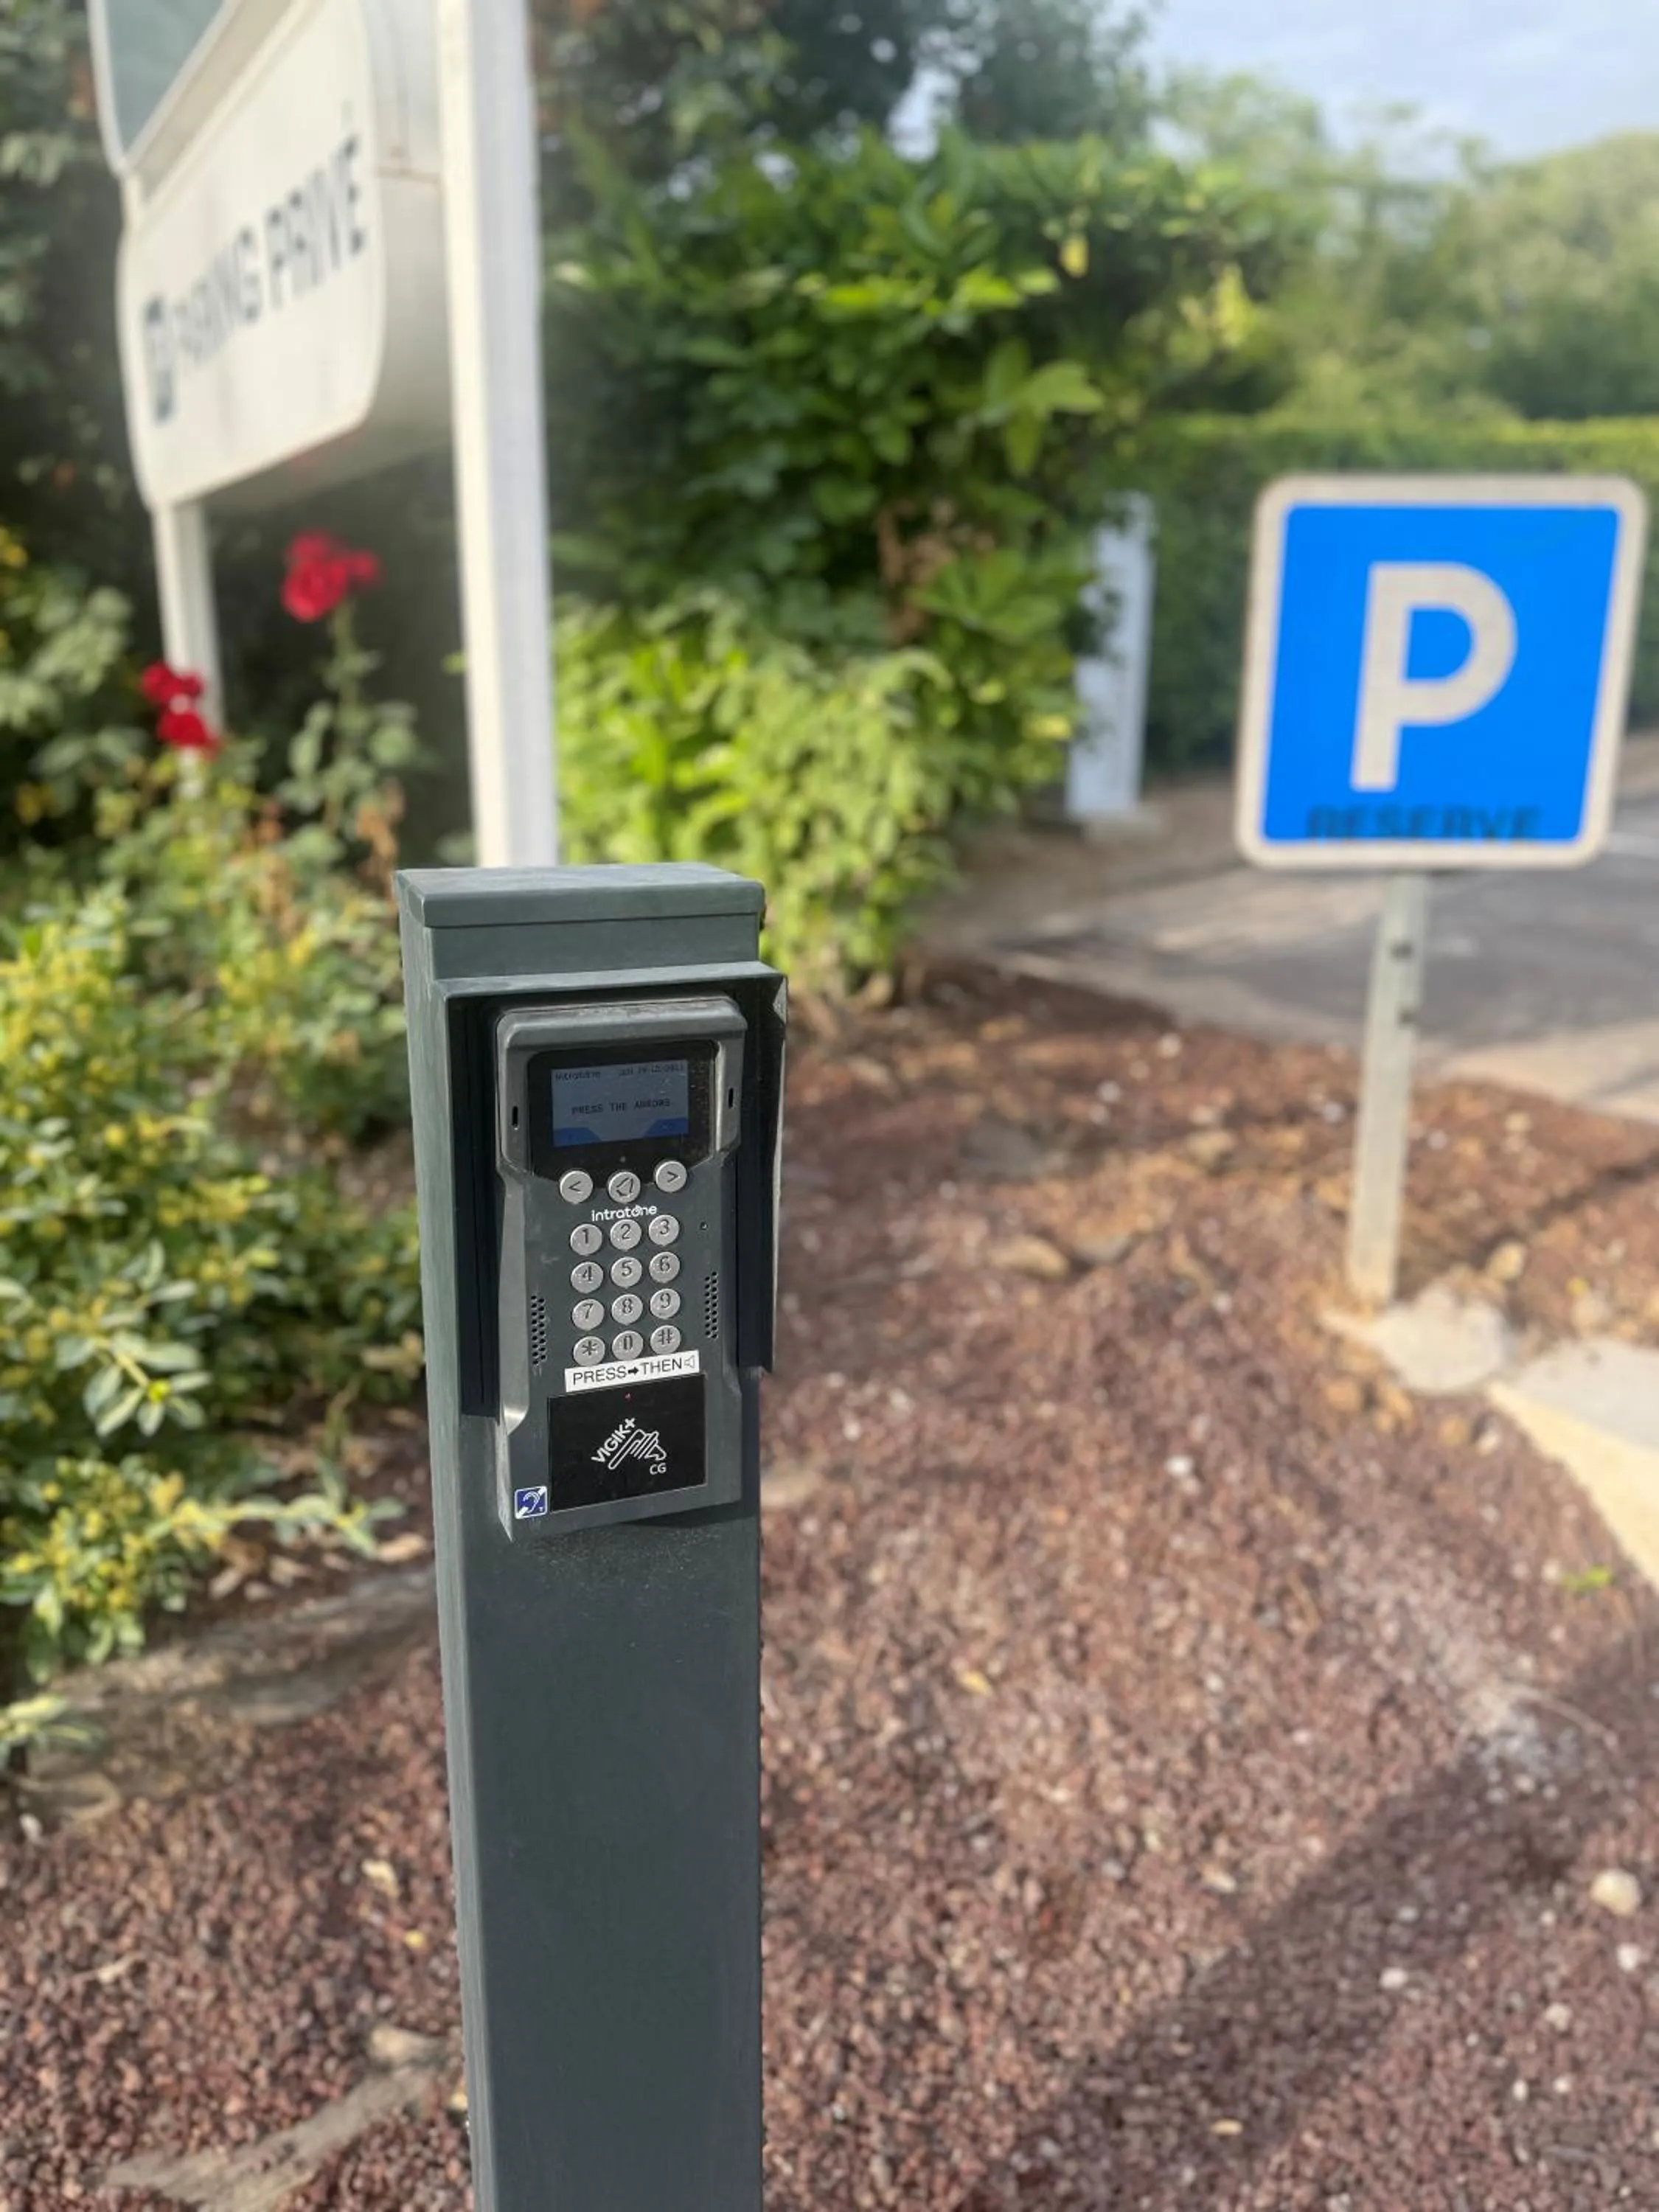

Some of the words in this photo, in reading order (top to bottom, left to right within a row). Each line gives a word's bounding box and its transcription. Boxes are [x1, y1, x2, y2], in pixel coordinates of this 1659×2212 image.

[1350, 560, 1517, 793] P
[573, 1366, 627, 1385] PRESS
[643, 1357, 682, 1375] THEN
[650, 1463, 667, 1475] CG
